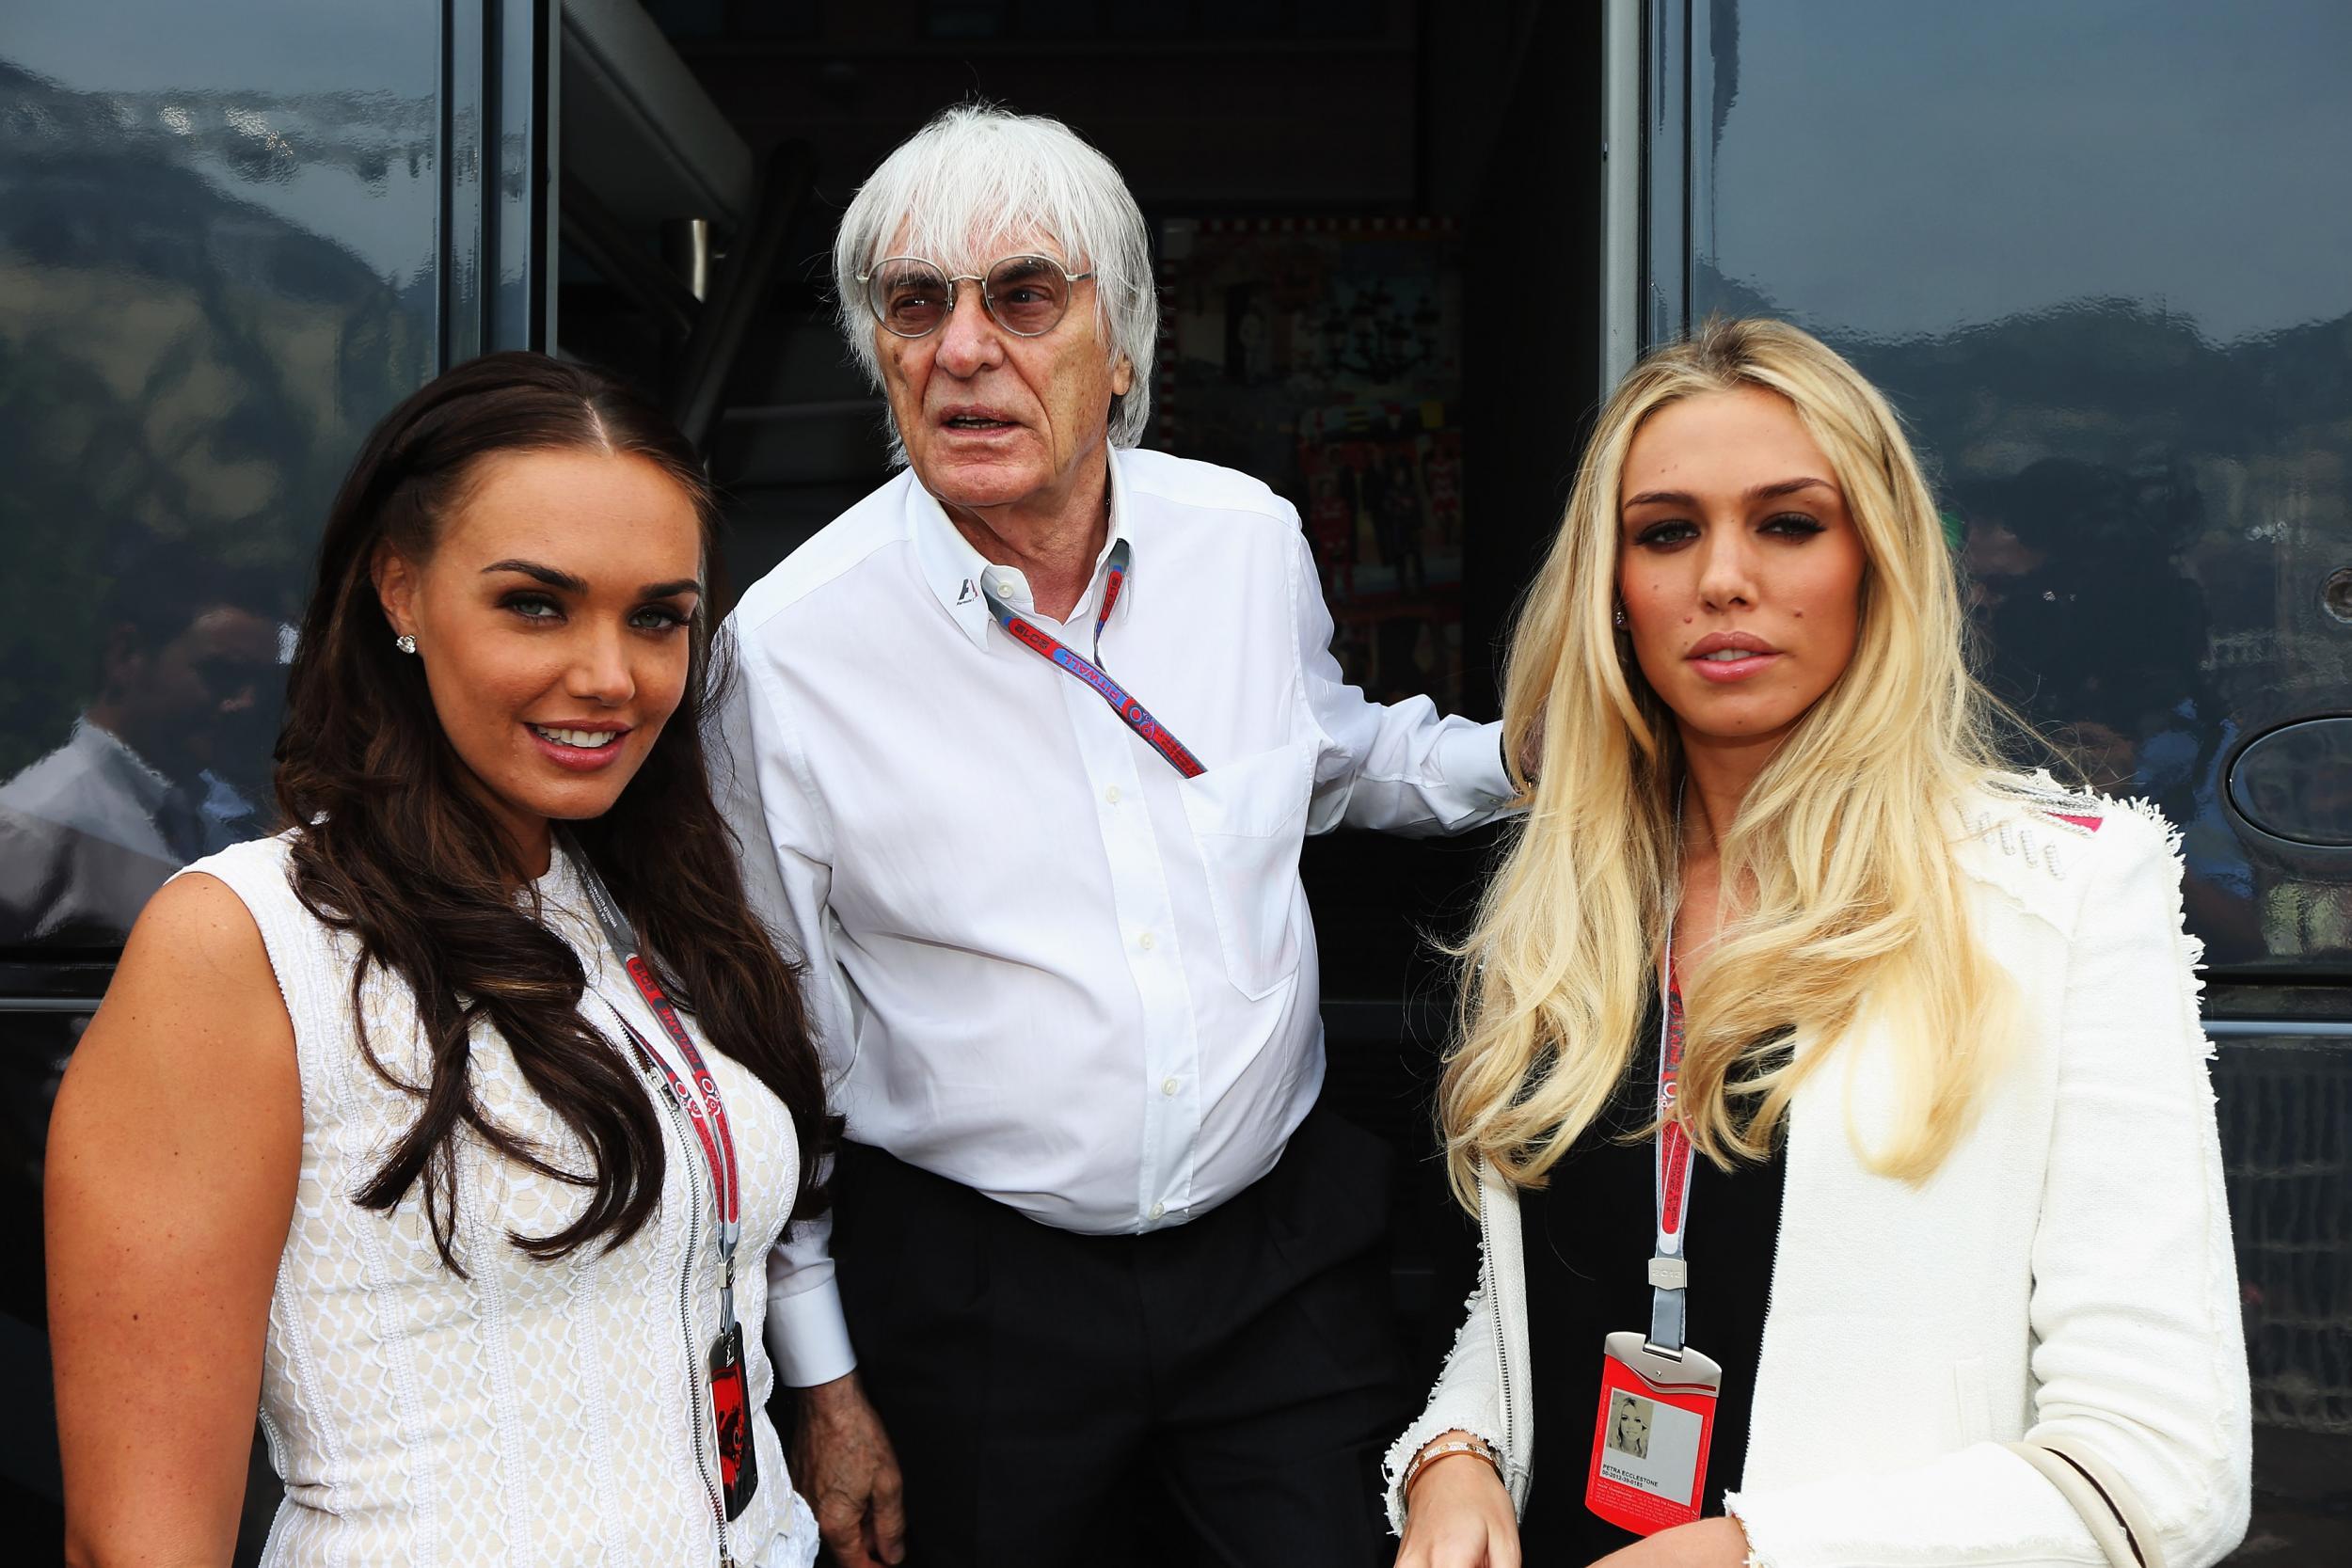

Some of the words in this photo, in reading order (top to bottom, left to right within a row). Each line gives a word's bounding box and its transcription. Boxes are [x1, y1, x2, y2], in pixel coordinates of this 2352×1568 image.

[1013, 623, 1051, 651] 2012
[1061, 652, 1120, 702] PITWALL
[660, 1006, 700, 1061] PITLANE
[1602, 1464, 1621, 1475] PETRA
[1621, 1469, 1659, 1488] ECCLESTONE
